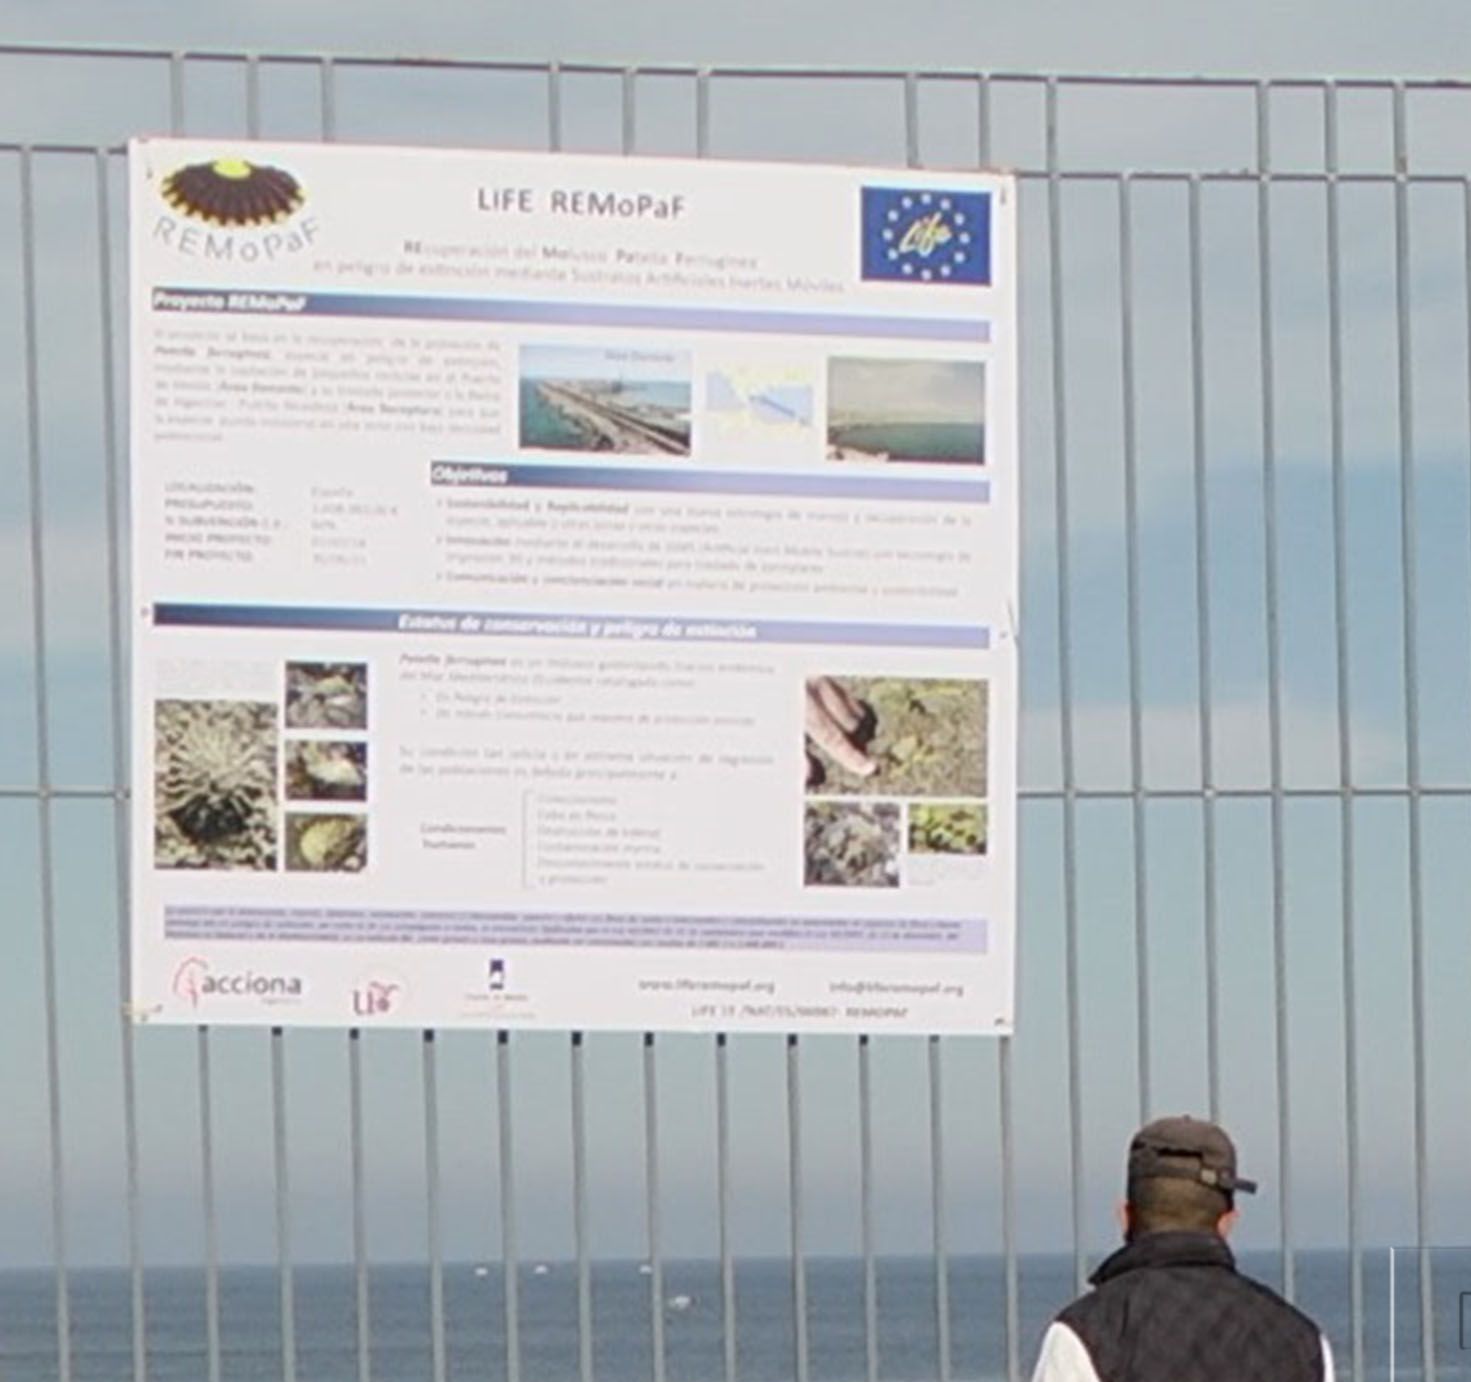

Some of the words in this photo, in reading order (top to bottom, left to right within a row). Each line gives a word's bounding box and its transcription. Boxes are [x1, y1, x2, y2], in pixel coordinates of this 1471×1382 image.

[478, 187, 533, 212] LIFE
[551, 190, 685, 219] REMoPaF
[153, 215, 318, 262] REMoPaF
[899, 211, 952, 257] Life
[155, 290, 224, 311] Proyecto
[228, 293, 306, 312] REMoPaF
[433, 466, 508, 485] Objetivos
[460, 616, 479, 631] de
[483, 617, 587, 633] conservación
[603, 620, 657, 639] peligro
[663, 621, 681, 636] de
[685, 622, 757, 638] extinción
[202, 972, 302, 995] acciona
